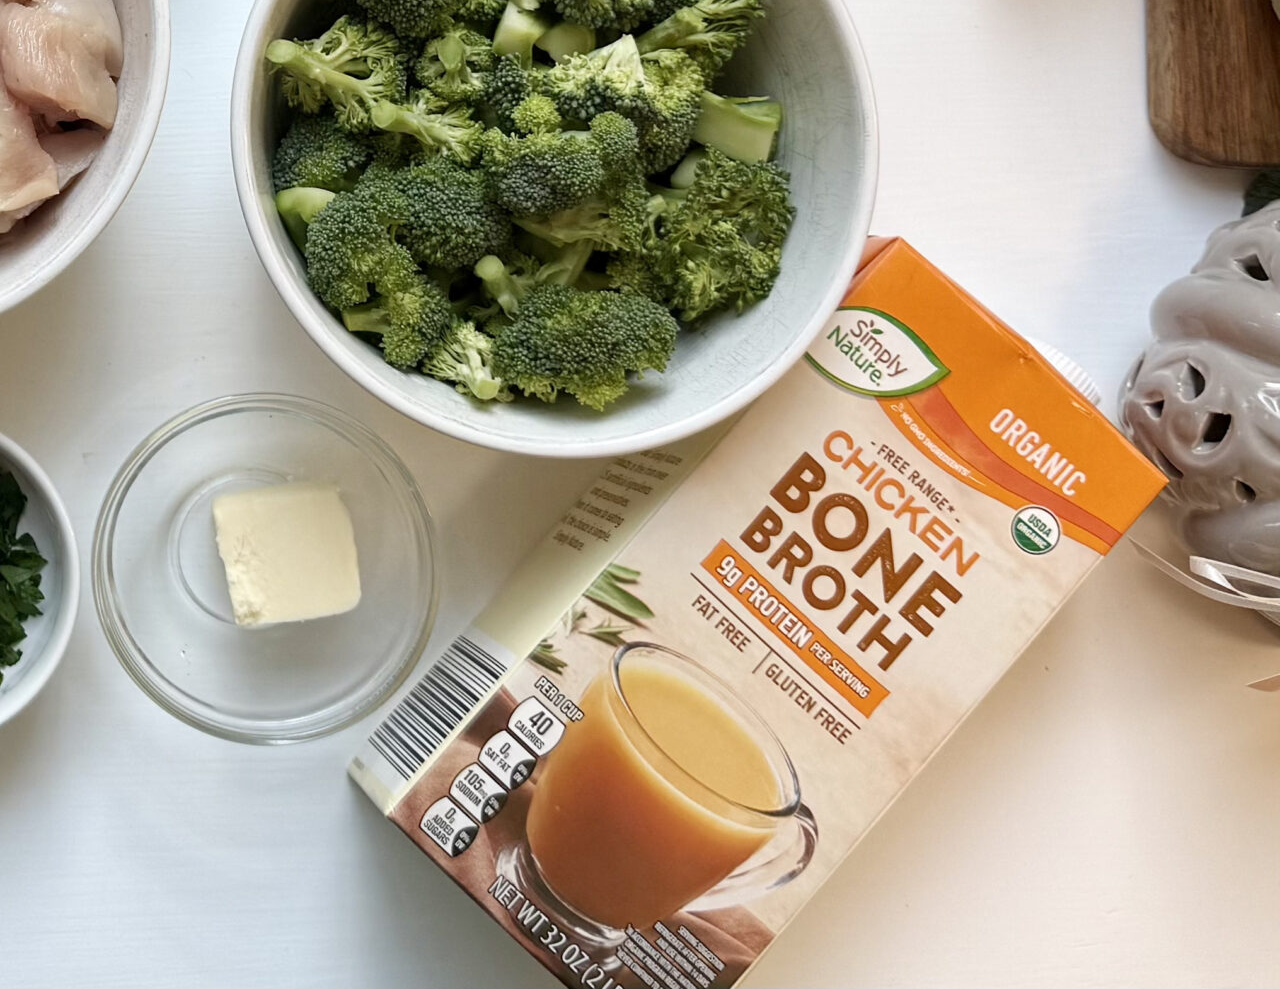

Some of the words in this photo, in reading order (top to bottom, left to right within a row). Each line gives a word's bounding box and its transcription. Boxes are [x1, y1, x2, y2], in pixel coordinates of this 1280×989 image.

[849, 320, 908, 378] Simply
[901, 412, 911, 425] NO
[910, 423, 926, 440] GMO
[878, 445, 910, 474] FREE
[990, 408, 1086, 497] ORGANIC
[824, 430, 980, 576] CHICKEN
[1017, 522, 1047, 549] ORGANIC
[1028, 514, 1051, 537] USDA
[770, 452, 962, 637] BONE
[740, 506, 912, 671] BROTH
[717, 557, 742, 586] 9g
[739, 577, 812, 647] PROTEIN
[810, 643, 831, 663] PER
[829, 660, 869, 697] SERVING
[692, 595, 719, 620] FAT
[715, 617, 751, 652] FREE
[765, 664, 816, 713] GLUTEN
[814, 708, 852, 744] FREE
[535, 676, 558, 701] PER
[556, 694, 565, 708] 1
[561, 698, 584, 722] CUP
[515, 720, 545, 750] CALORIES
[529, 711, 554, 736] 40
[485, 748, 500, 763] SAT
[497, 760, 511, 773] FAT
[455, 780, 481, 807] SODIUM
[423, 820, 450, 845] SUGARS
[432, 814, 455, 836] ADDED
[488, 875, 524, 910] NET
[517, 900, 549, 932] WT
[540, 925, 567, 953] 32
[562, 944, 589, 973] OZ
[582, 964, 605, 989] (2
